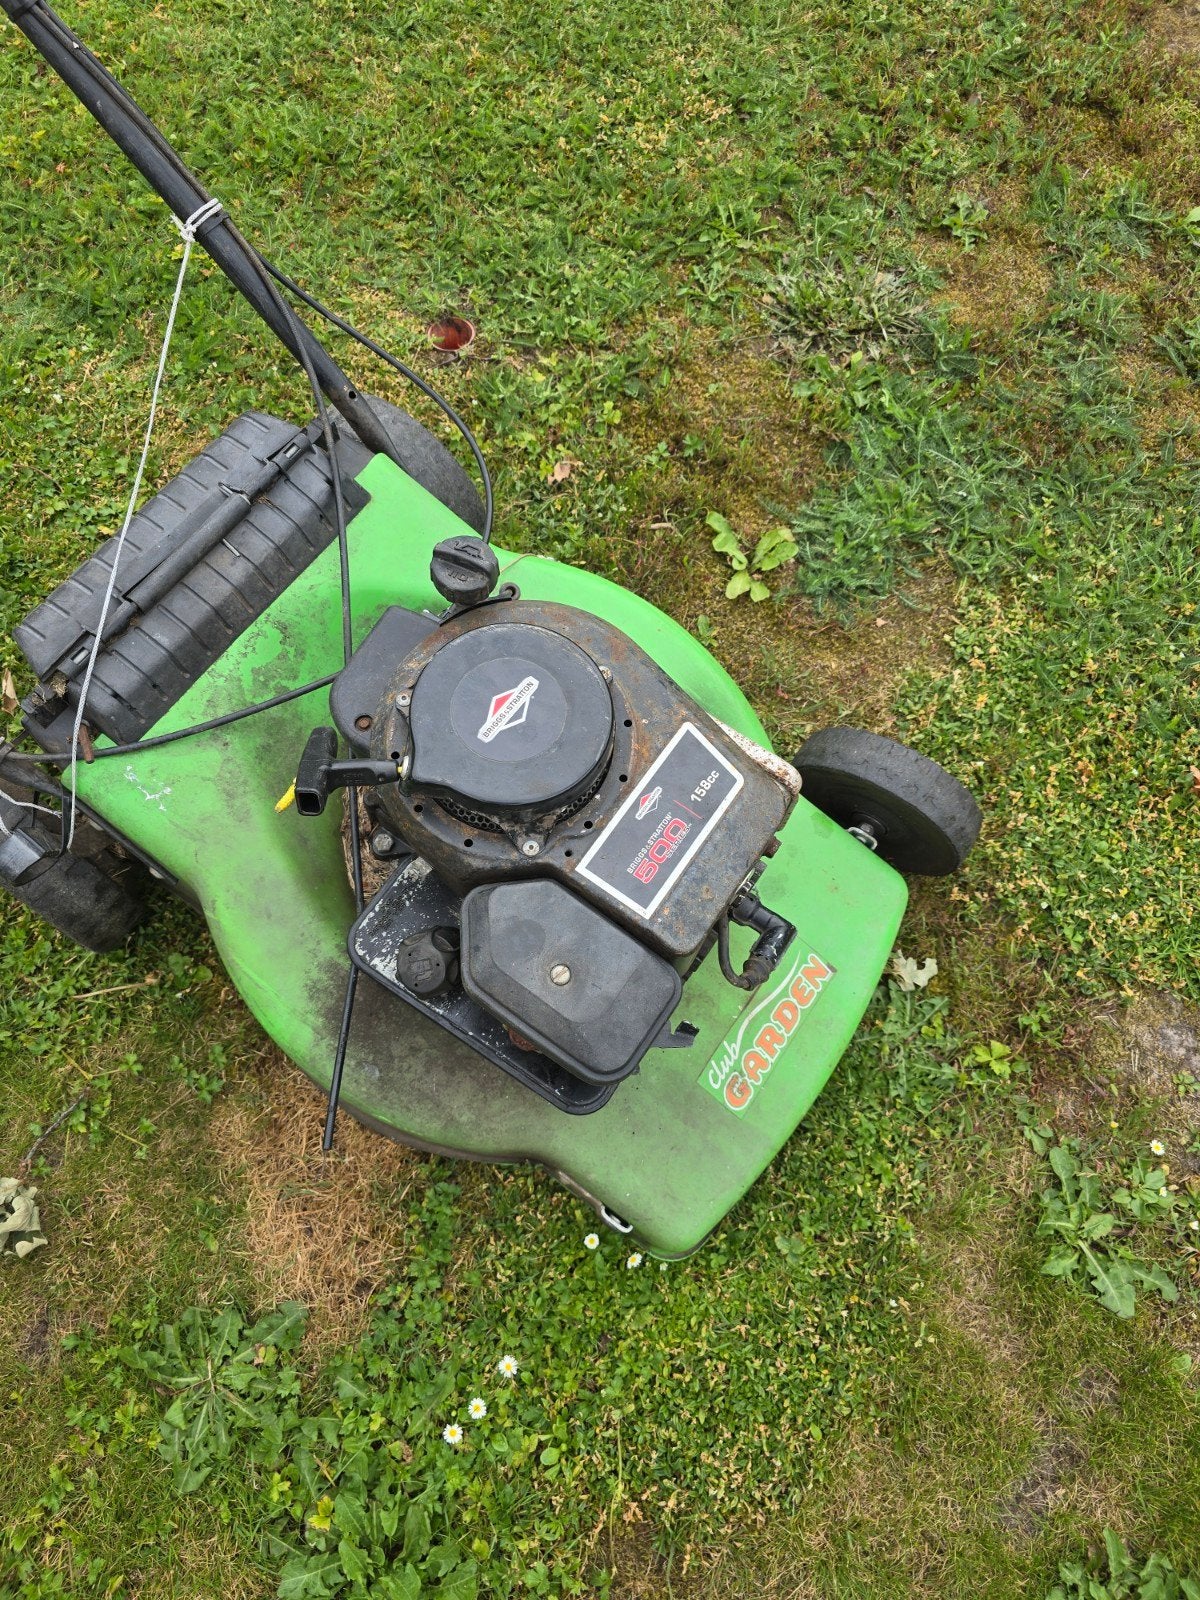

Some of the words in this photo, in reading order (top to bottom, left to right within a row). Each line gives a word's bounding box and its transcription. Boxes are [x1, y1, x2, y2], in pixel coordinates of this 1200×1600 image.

[691, 770, 720, 803] 158cc
[633, 818, 687, 884] 500
[724, 954, 833, 1110] GARDEN
